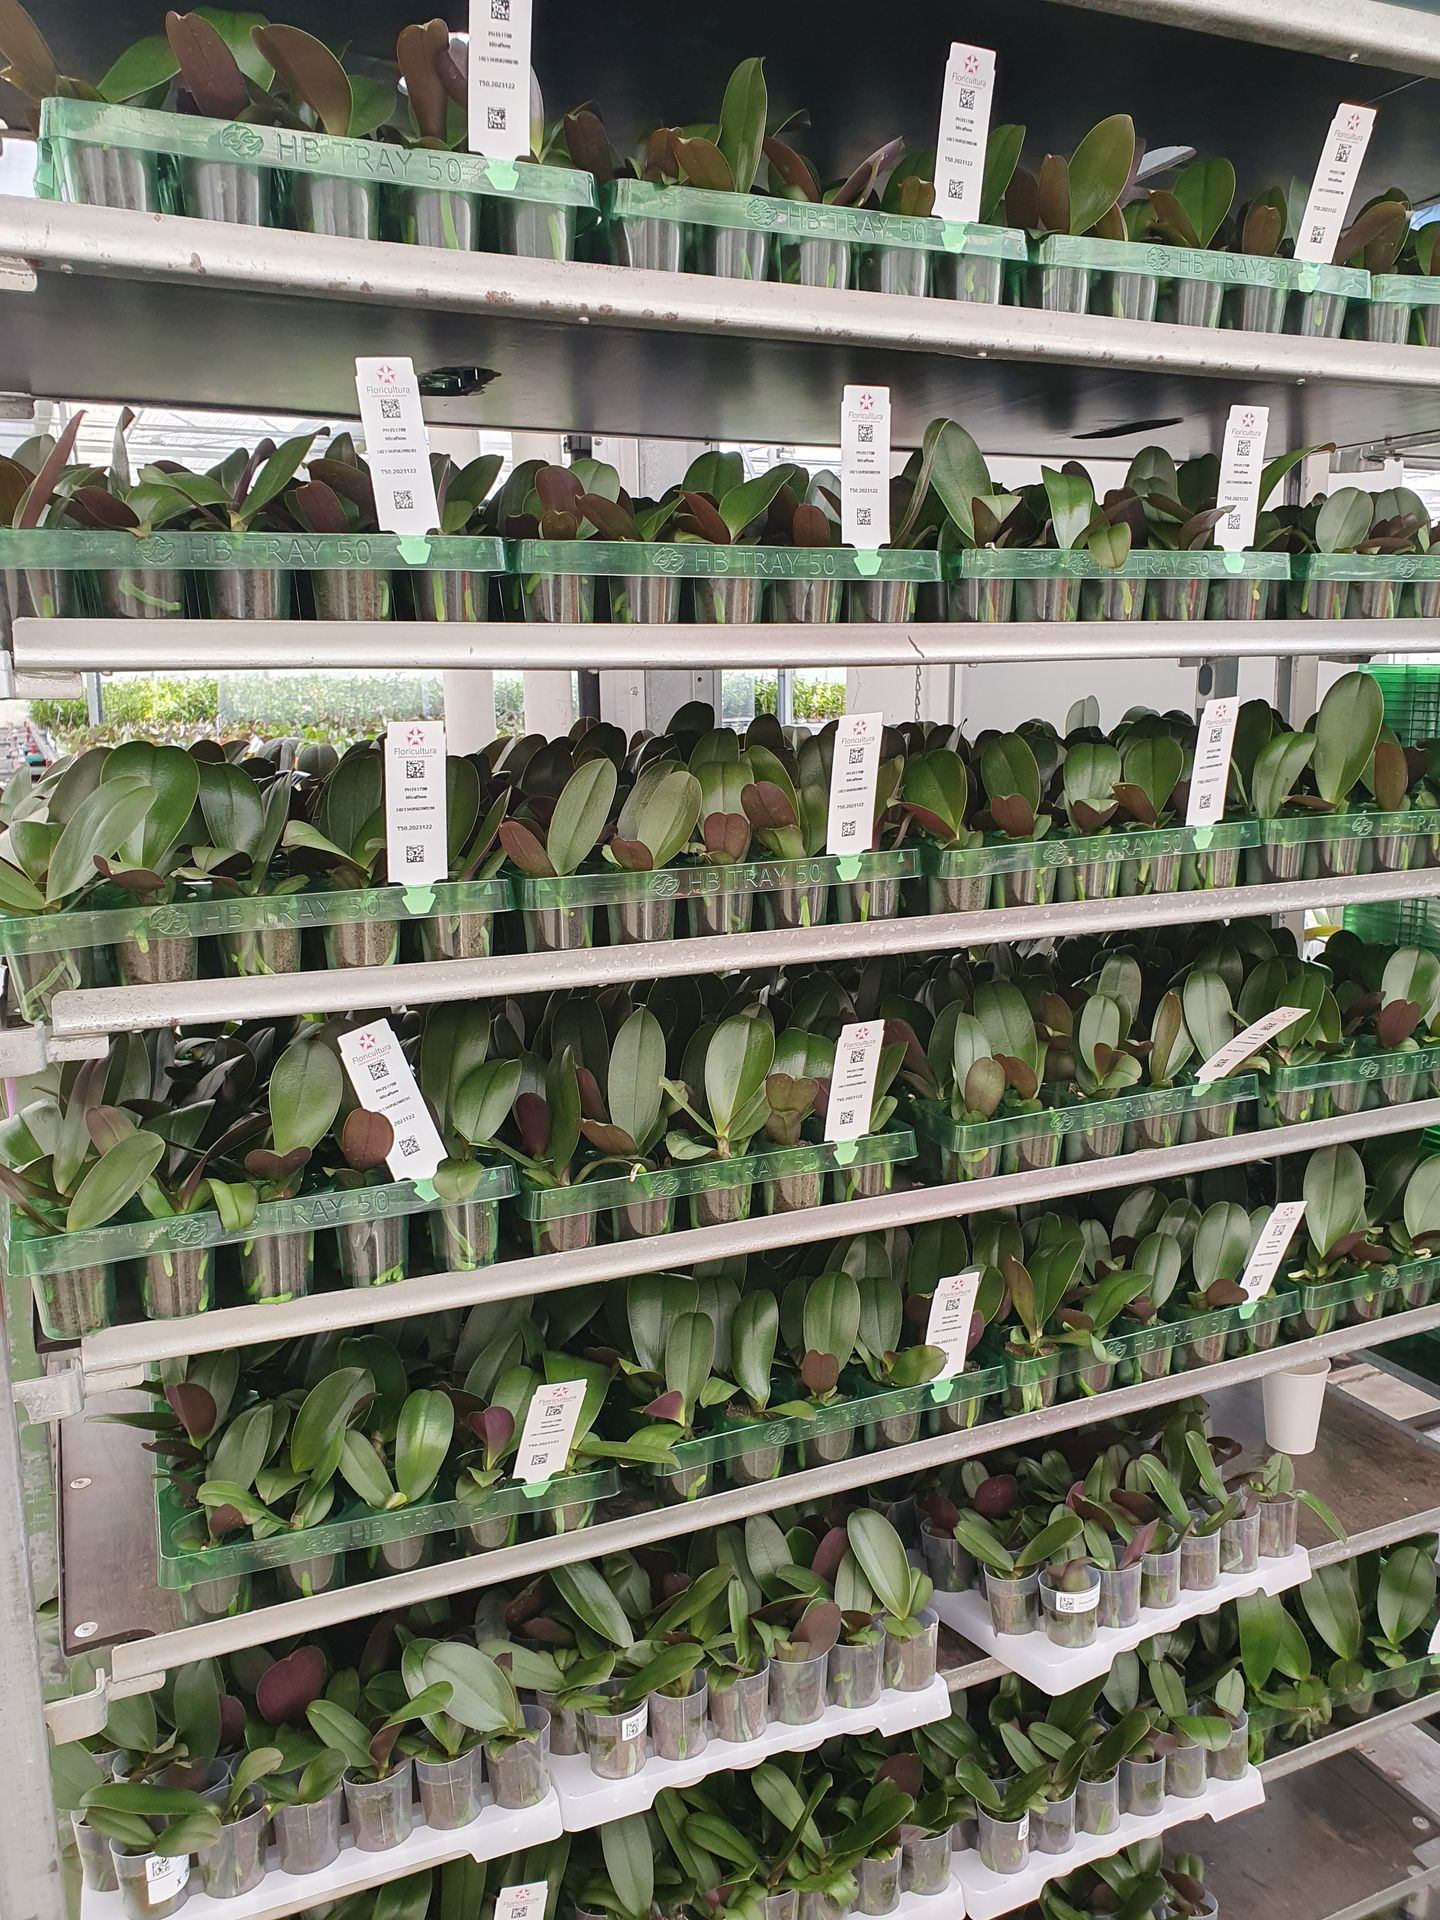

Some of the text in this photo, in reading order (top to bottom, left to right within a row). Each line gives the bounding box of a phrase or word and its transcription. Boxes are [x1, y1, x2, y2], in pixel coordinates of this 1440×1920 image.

[952, 72, 987, 87] Floricultura
[276, 133, 463, 184] HB TRAY 50
[787, 206, 927, 243] HB TRAY 50
[1178, 251, 1289, 283] HB TRAY 50
[366, 385, 411, 395] Floricultura
[188, 536, 372, 564] HB TRAY 50
[694, 551, 836, 576] HB TRAY 50
[1132, 555, 1180, 575] TRAY
[1188, 554, 1210, 576] 50
[393, 746, 438, 756] Floricultura
[841, 735, 876, 746] Floricultura
[396, 823, 433, 832] T50.2023122
[1379, 814, 1440, 833] HB TRA
[1076, 833, 1182, 861] HB TRAY 50
[688, 863, 821, 893] HB TRAY 50
[203, 895, 381, 930] HB TRAY 50
[351, 1043, 393, 1066] Floricultura
[1411, 1053, 1440, 1070] TRA
[1112, 1096, 1155, 1121] TRAY
[1163, 1092, 1185, 1112] 50
[393, 1112, 416, 1127] 2023122
[689, 1168, 720, 1190] HB
[728, 1156, 785, 1183] TRAY
[274, 1196, 344, 1230] TRAY
[357, 1190, 390, 1216] 50
[1133, 1334, 1156, 1354] HB
[350, 1521, 385, 1546] HB
